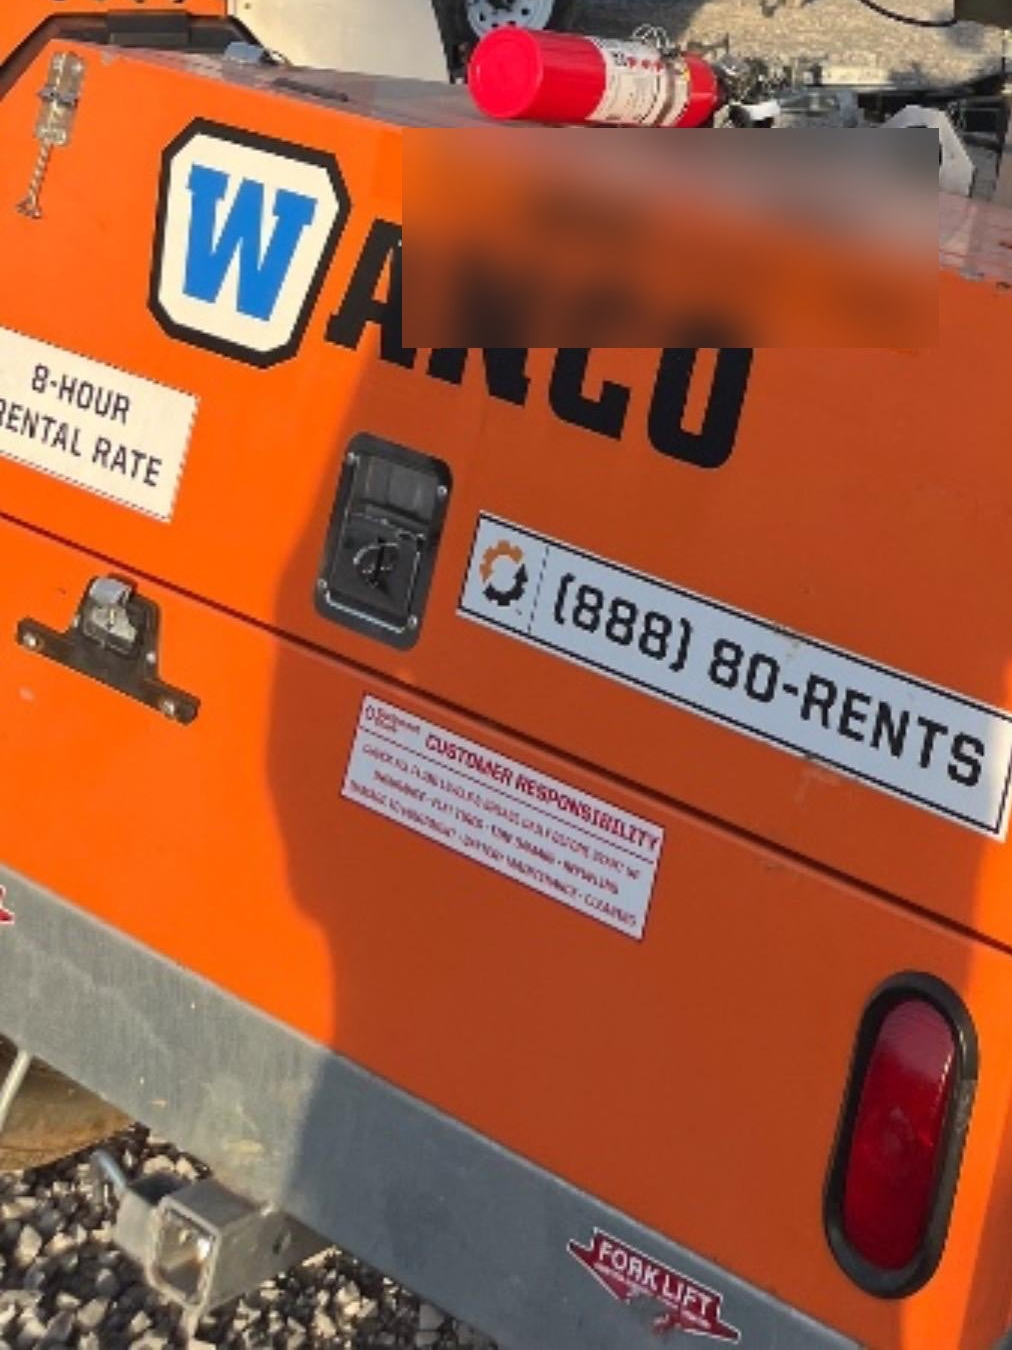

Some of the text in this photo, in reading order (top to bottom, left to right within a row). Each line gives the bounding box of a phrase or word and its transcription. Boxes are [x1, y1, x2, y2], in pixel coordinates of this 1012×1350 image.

[32, 363, 131, 426] 8-HOUR
[92, 435, 163, 488] RATE
[554, 572, 986, 787] (888) 80-RENTS
[424, 733, 513, 788] CUSTOMER
[514, 772, 660, 851] RESPONSIBILITY
[598, 1240, 659, 1292] FORK
[662, 1274, 713, 1316] LIFT
